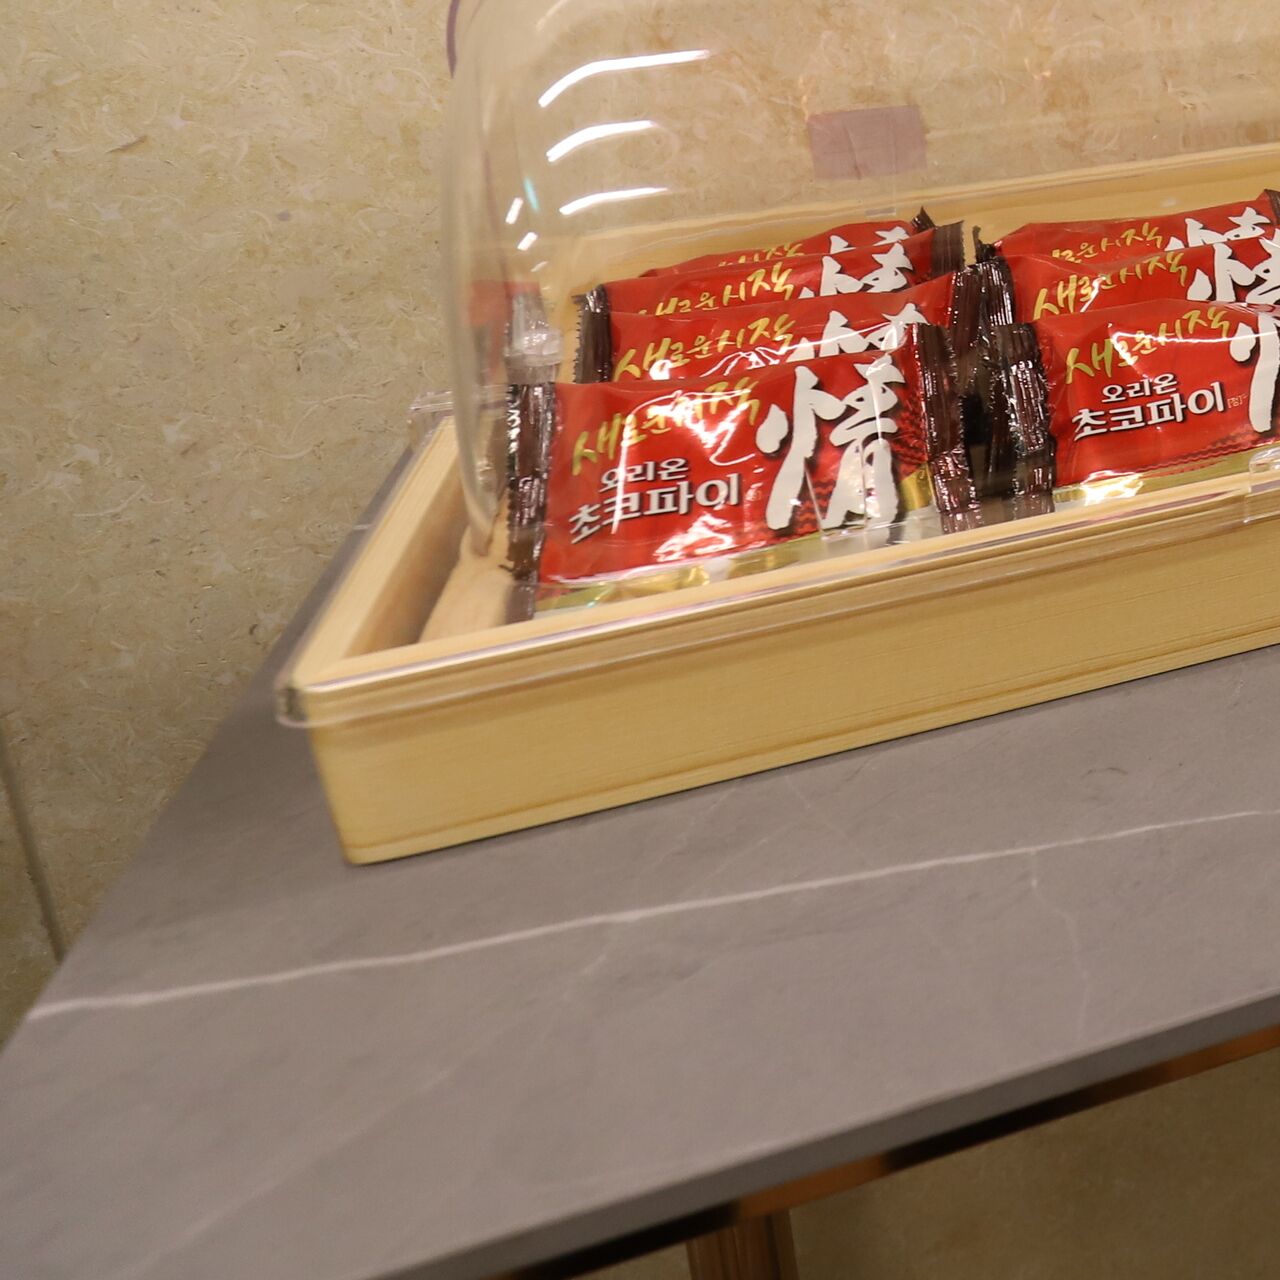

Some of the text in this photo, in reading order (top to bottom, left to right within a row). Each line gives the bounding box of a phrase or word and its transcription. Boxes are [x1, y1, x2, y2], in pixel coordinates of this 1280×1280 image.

[1071, 381, 1226, 442] 초코파이
[1101, 373, 1179, 404] 오리온
[598, 457, 690, 494] 오리온
[755, 352, 907, 546] 情
[568, 472, 741, 546] 초코파이
